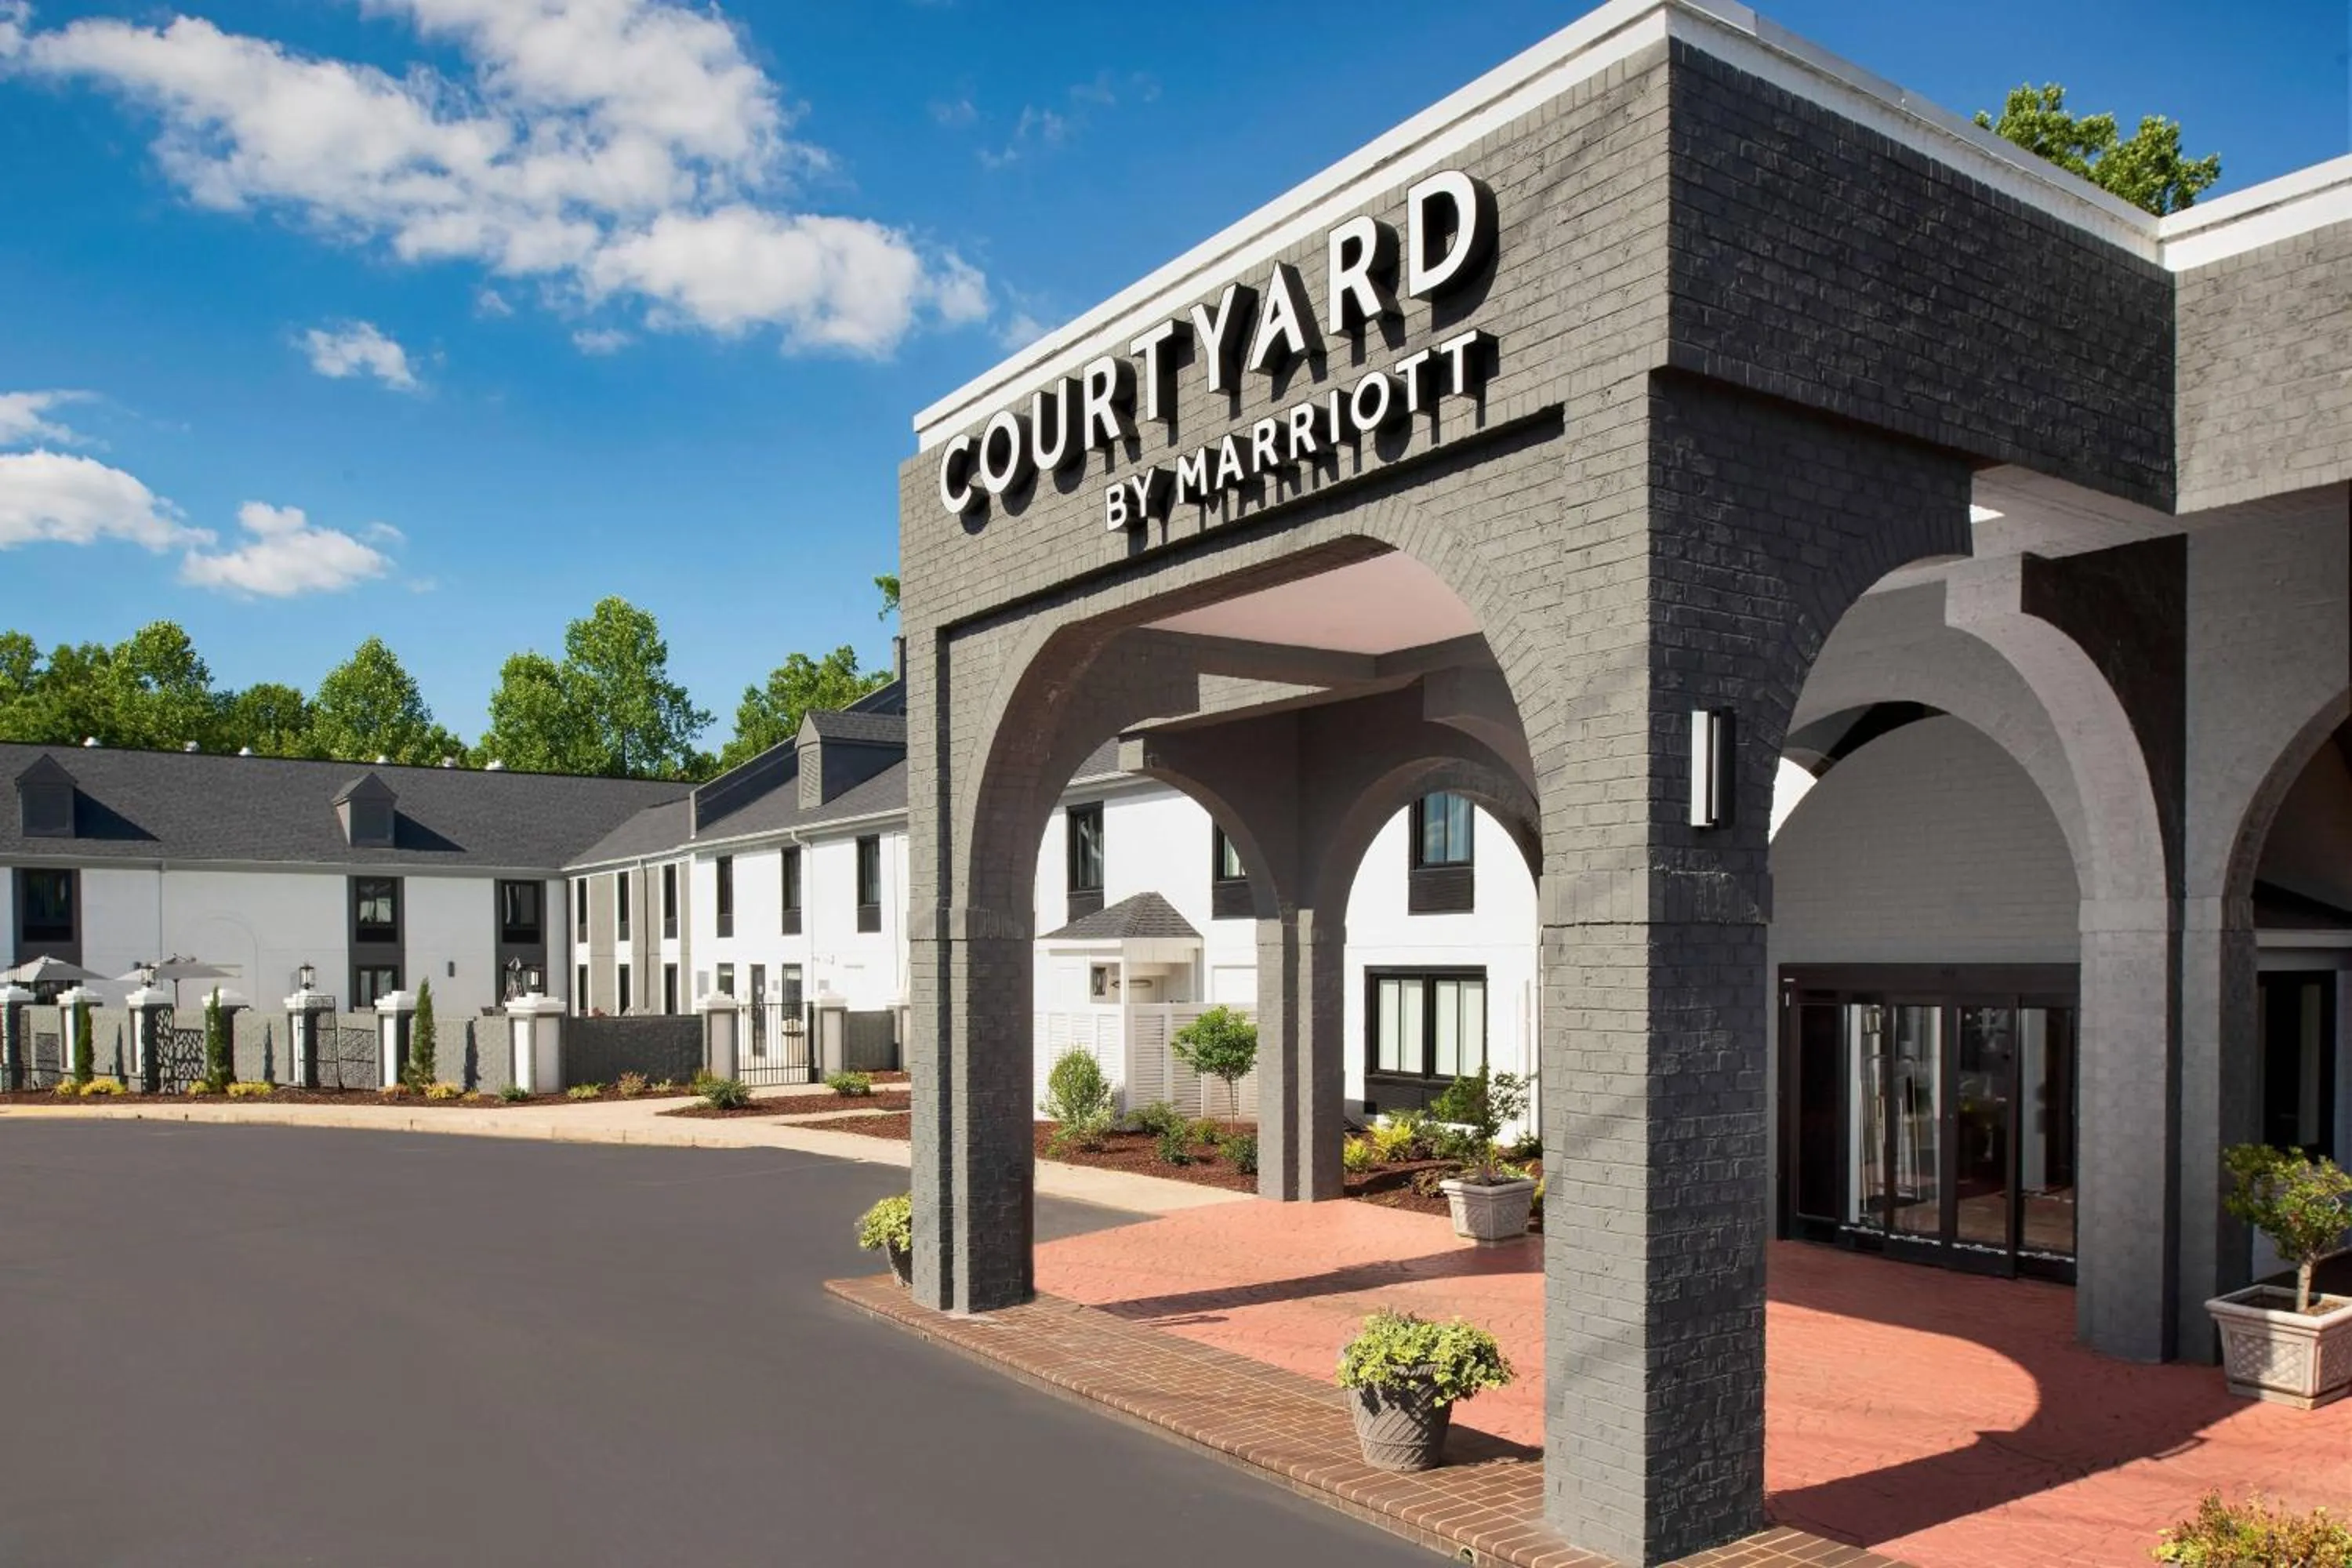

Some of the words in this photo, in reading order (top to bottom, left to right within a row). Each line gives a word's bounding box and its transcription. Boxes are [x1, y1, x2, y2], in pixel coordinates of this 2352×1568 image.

[940, 169, 1479, 514] COURTYARD
[1105, 467, 1156, 532] BY
[1178, 330, 1478, 504] MARRIOTT
